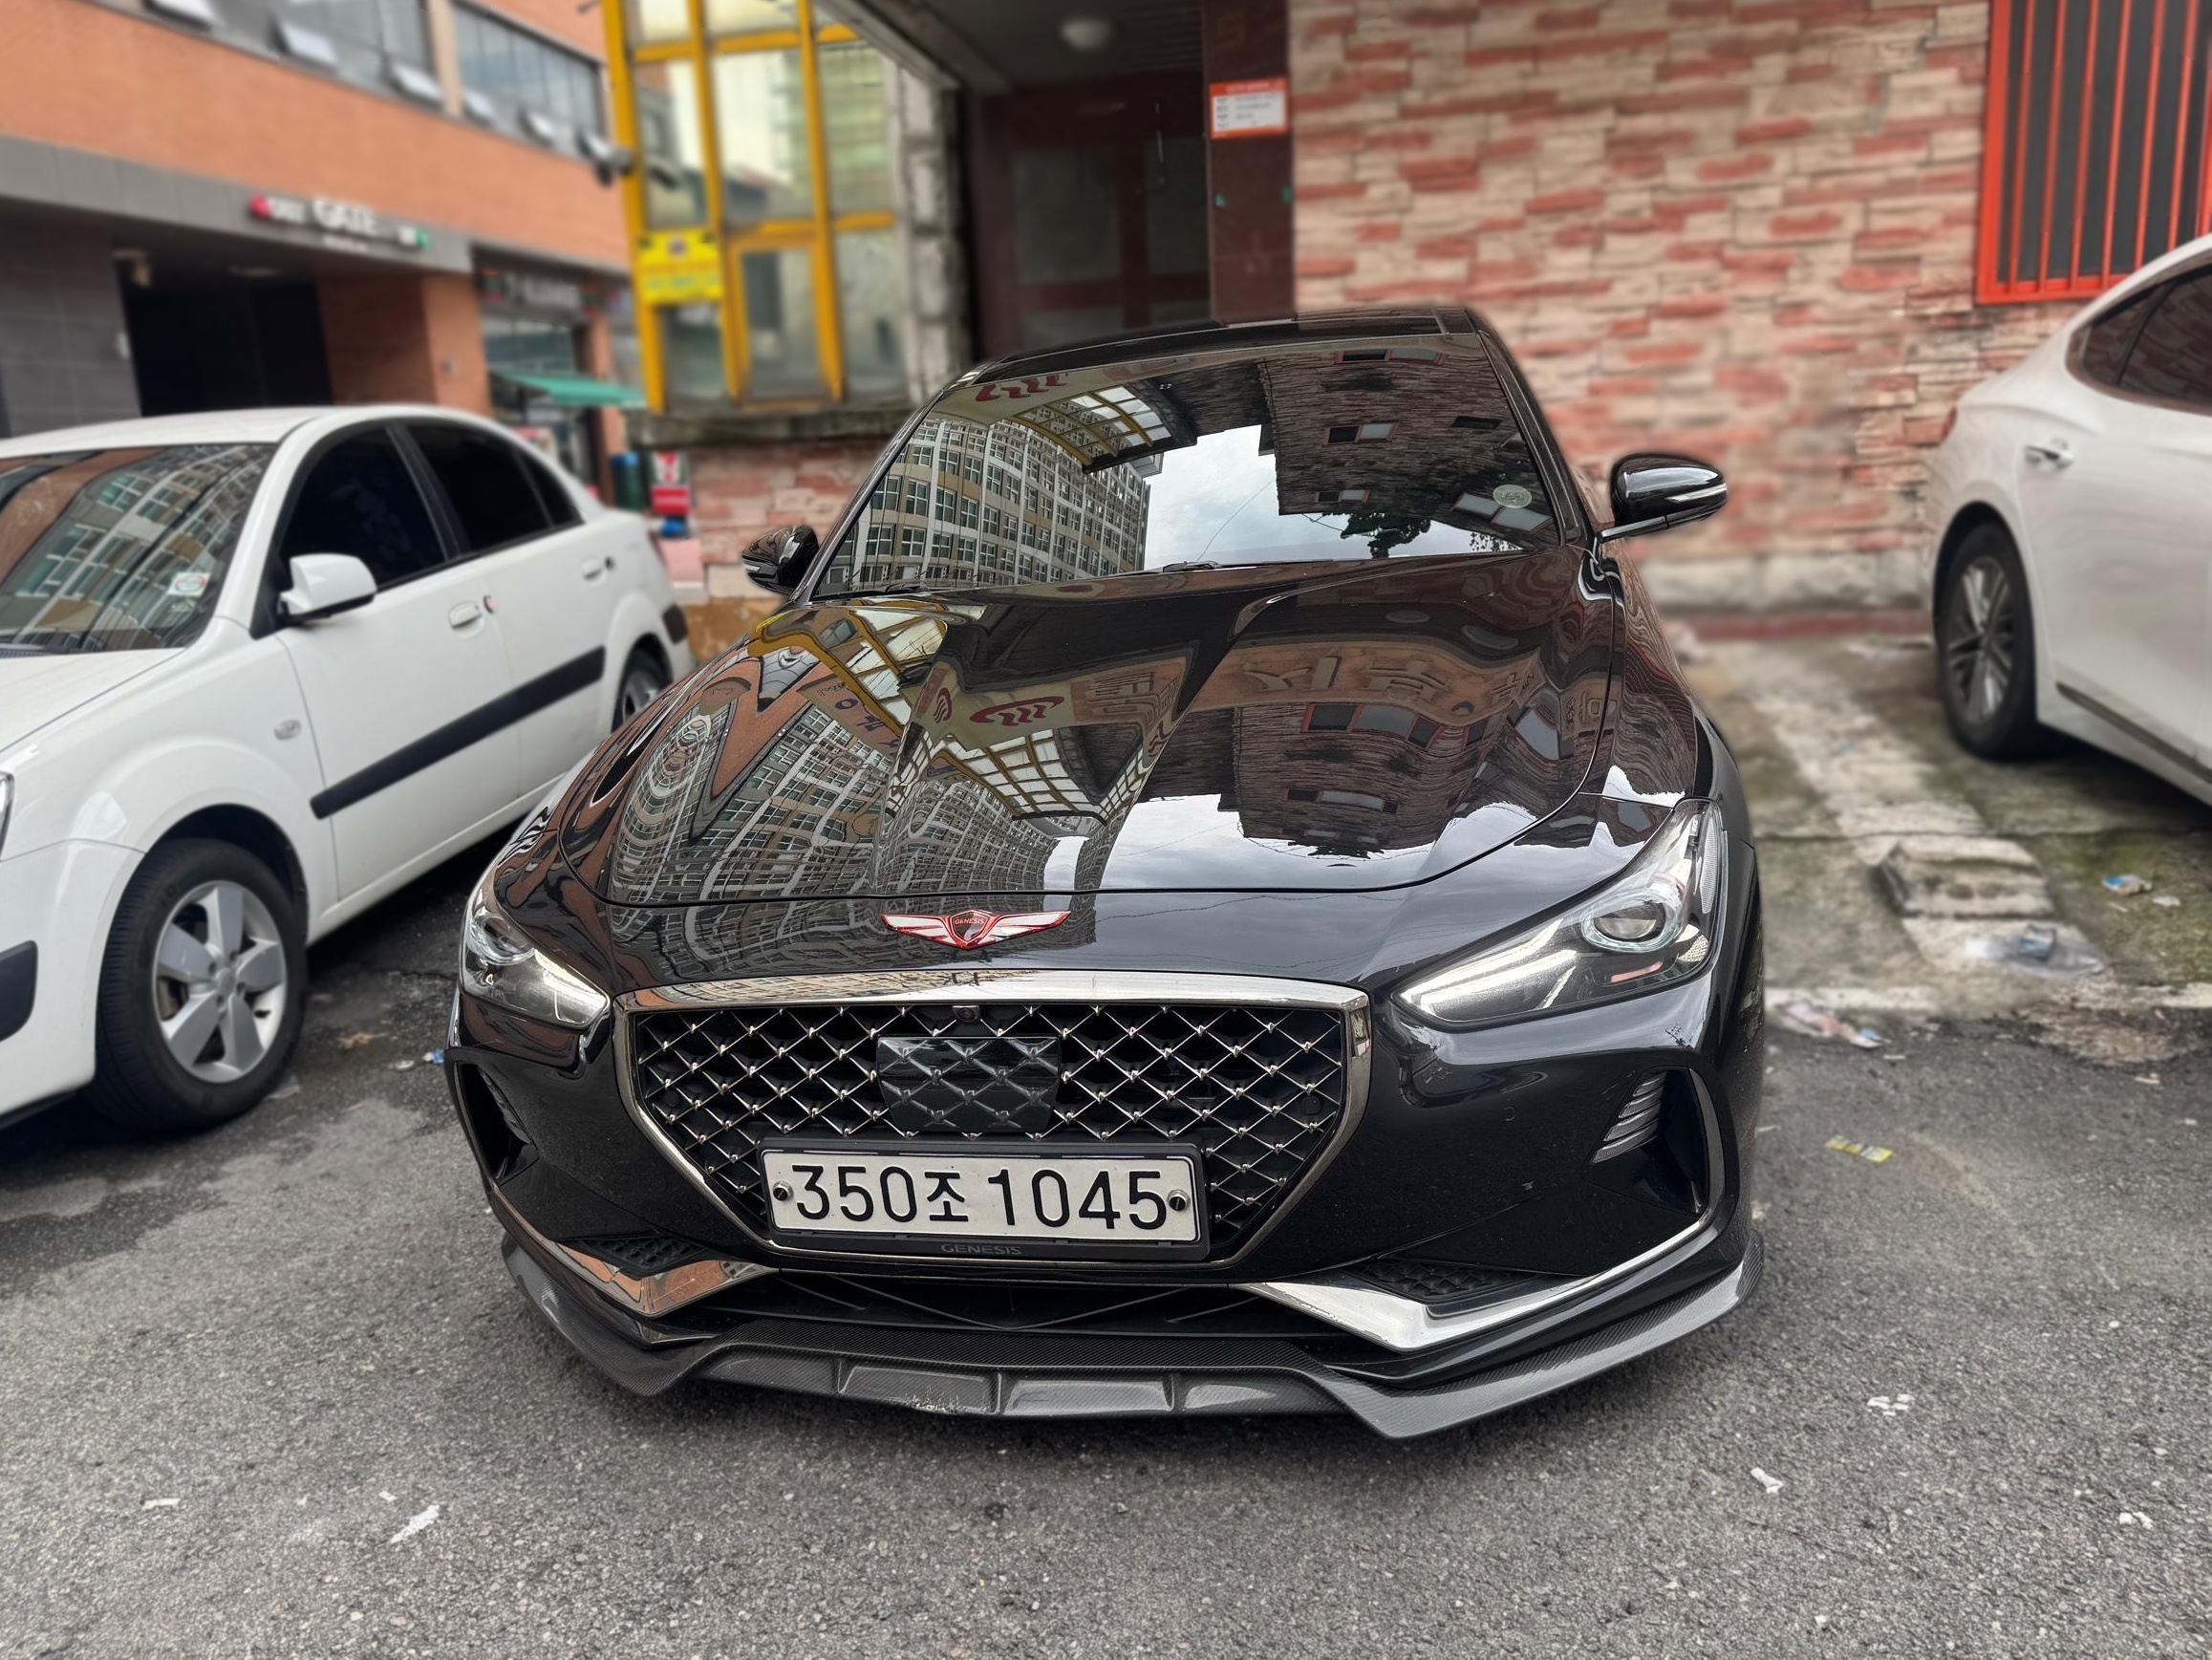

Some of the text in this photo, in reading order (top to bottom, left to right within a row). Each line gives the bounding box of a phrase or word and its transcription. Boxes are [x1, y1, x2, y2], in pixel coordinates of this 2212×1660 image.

[791, 1164, 1168, 1230] 350조 1045
[941, 1243, 1021, 1255] GENESIS
